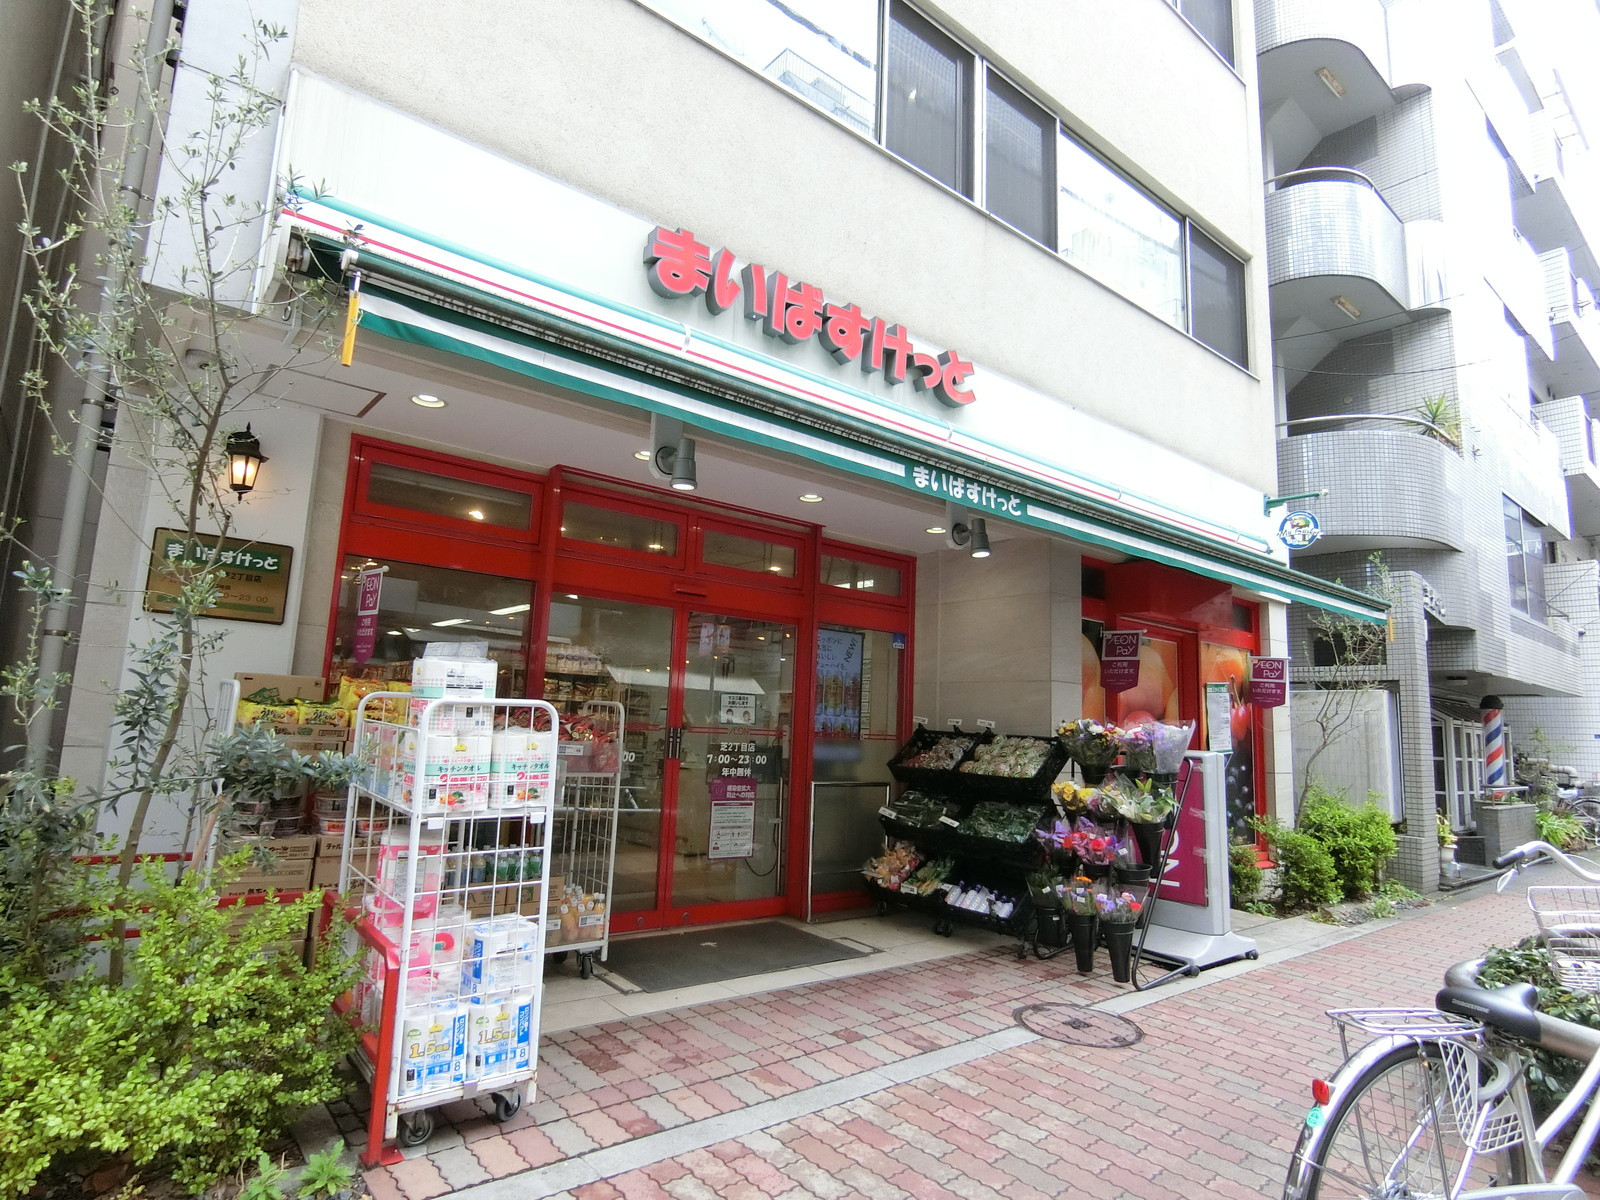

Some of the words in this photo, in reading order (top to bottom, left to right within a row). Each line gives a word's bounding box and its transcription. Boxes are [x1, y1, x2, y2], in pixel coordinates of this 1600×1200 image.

[644, 226, 976, 408] まいばすけっと
[913, 465, 1022, 516] まいばすけっと
[720, 742, 755, 752] 芝2丁目店
[721, 767, 752, 777] 年中無休
